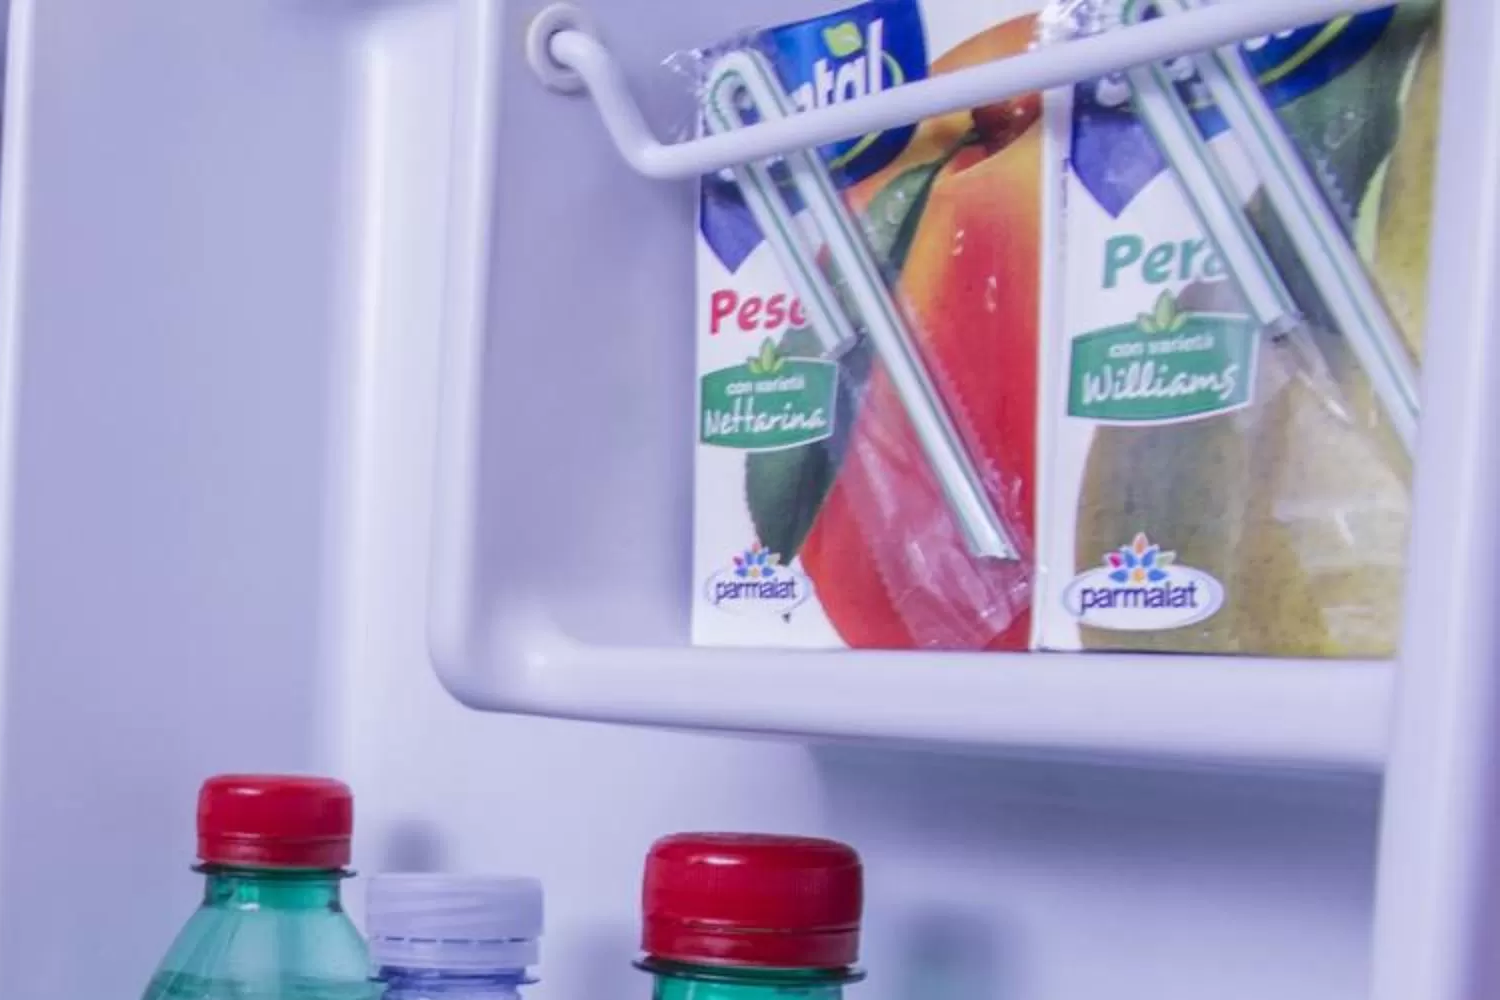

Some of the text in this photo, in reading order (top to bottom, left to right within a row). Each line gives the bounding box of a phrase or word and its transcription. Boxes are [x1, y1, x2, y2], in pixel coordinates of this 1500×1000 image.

[709, 289, 806, 336] Pesc
[1082, 359, 1240, 406] Williams
[703, 397, 828, 438] Nettarina
[713, 576, 797, 605] parmalat
[1081, 580, 1199, 616] parmalat
